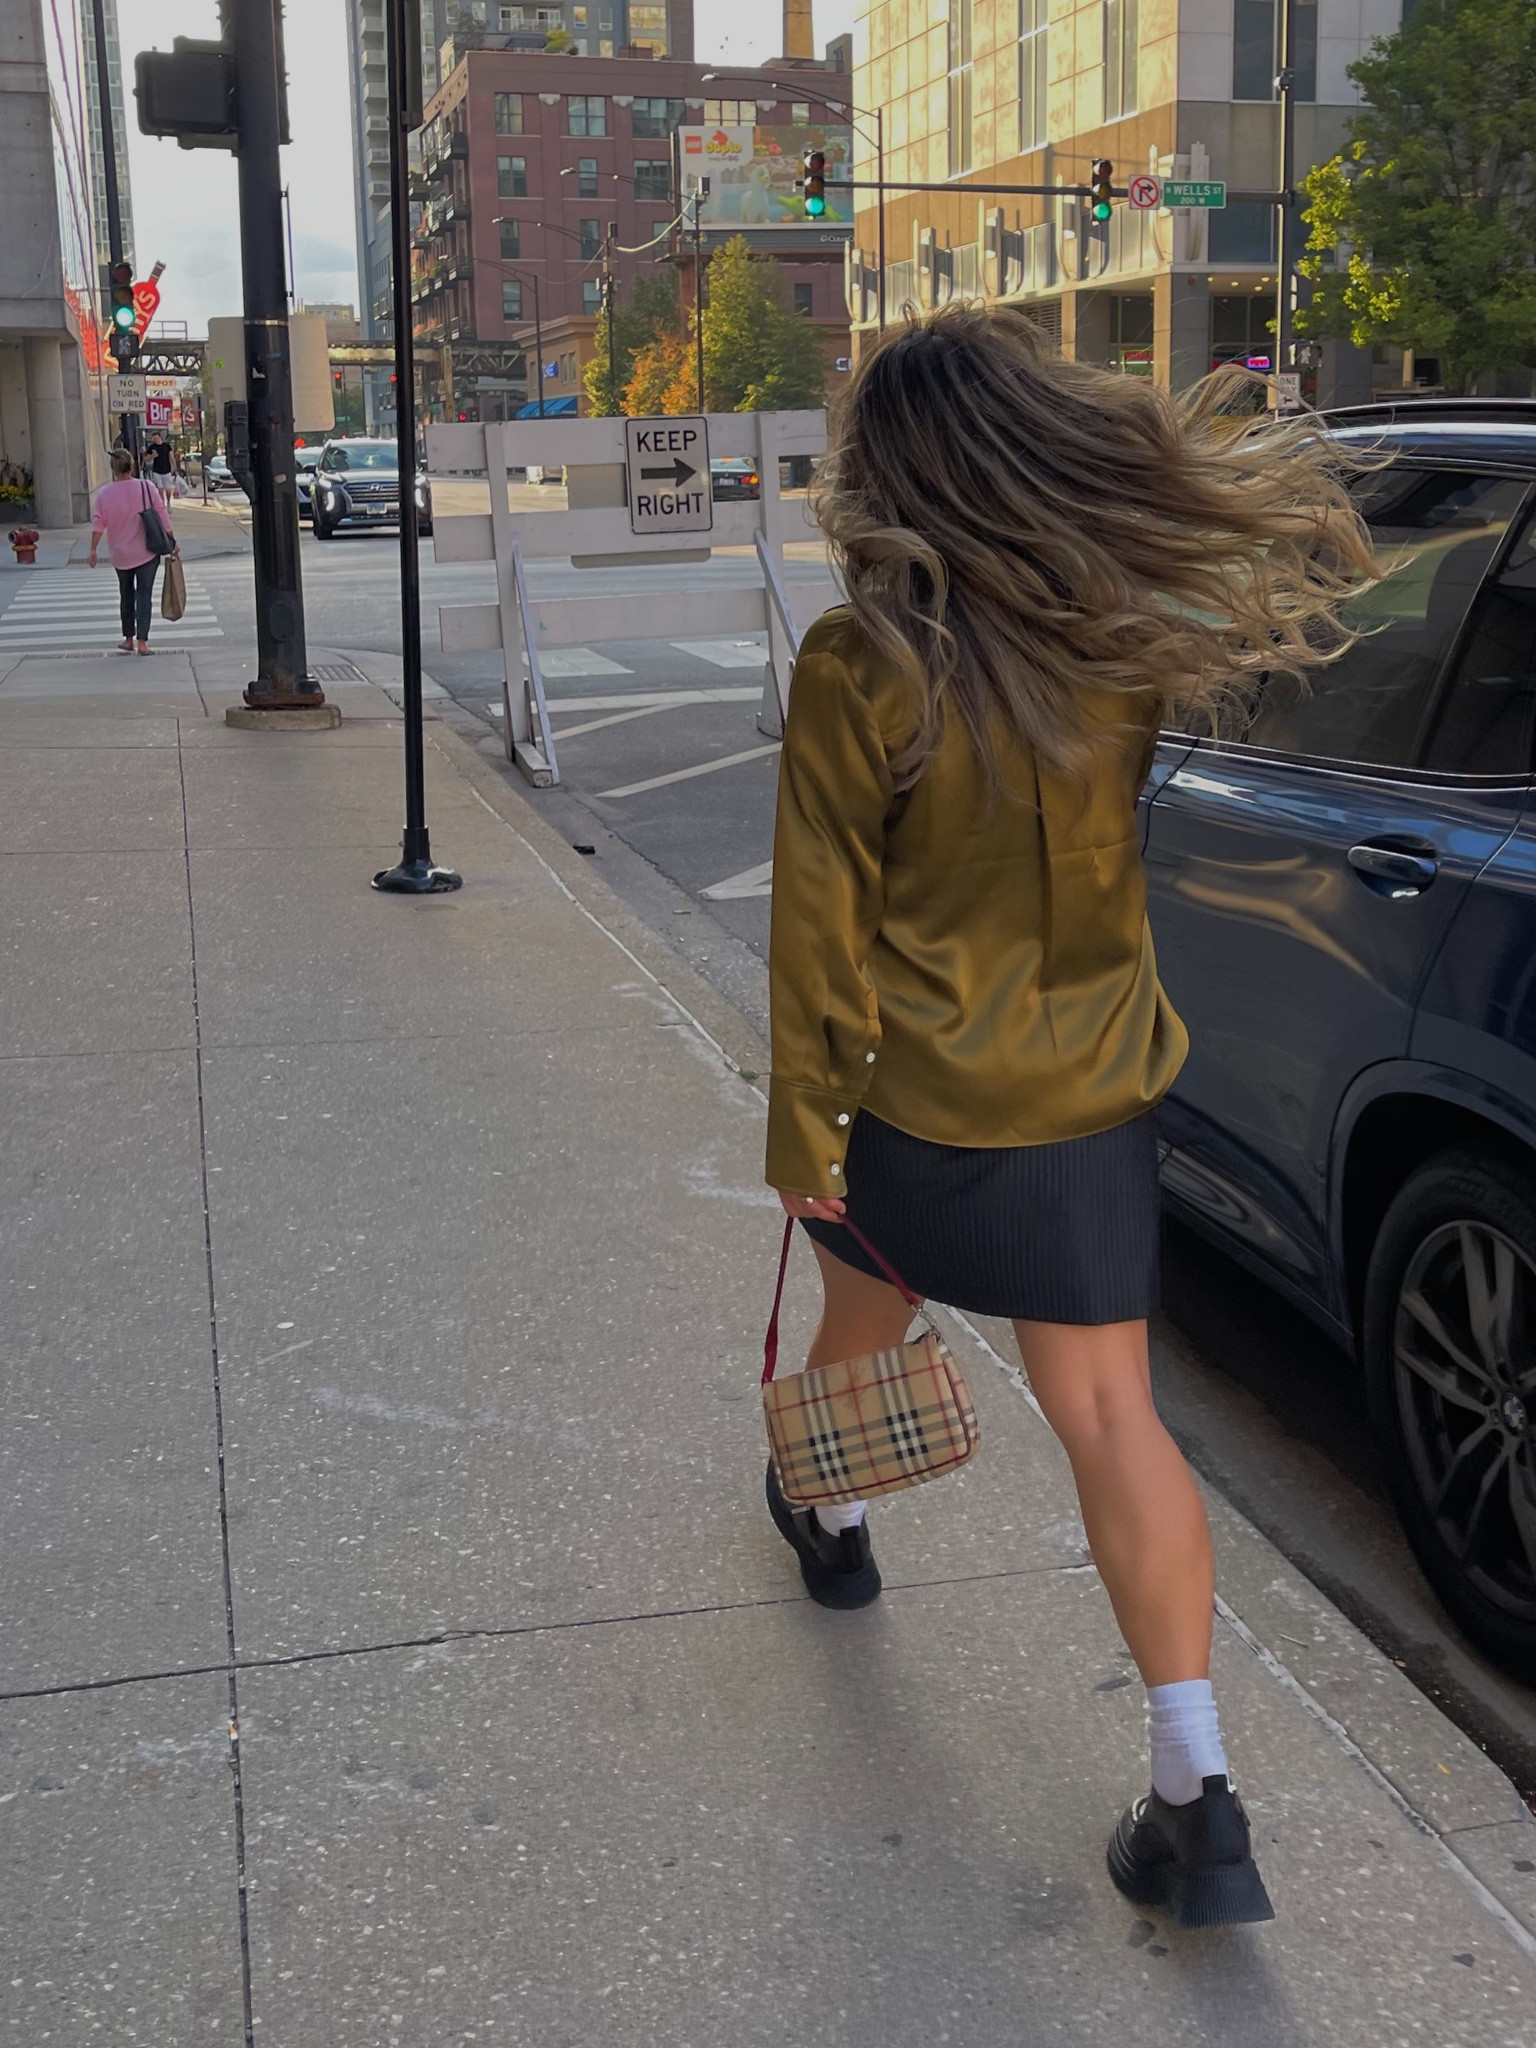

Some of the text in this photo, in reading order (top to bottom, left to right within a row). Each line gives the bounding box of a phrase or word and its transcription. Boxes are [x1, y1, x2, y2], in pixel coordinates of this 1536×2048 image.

[1165, 184, 1222, 196] N WELLS ST
[1180, 196, 1195, 205] 200
[120, 379, 134, 388] NO
[1280, 377, 1296, 386] ONE
[116, 390, 140, 398] TURN
[636, 430, 697, 453] KEEP
[637, 493, 704, 516] RIGHT
